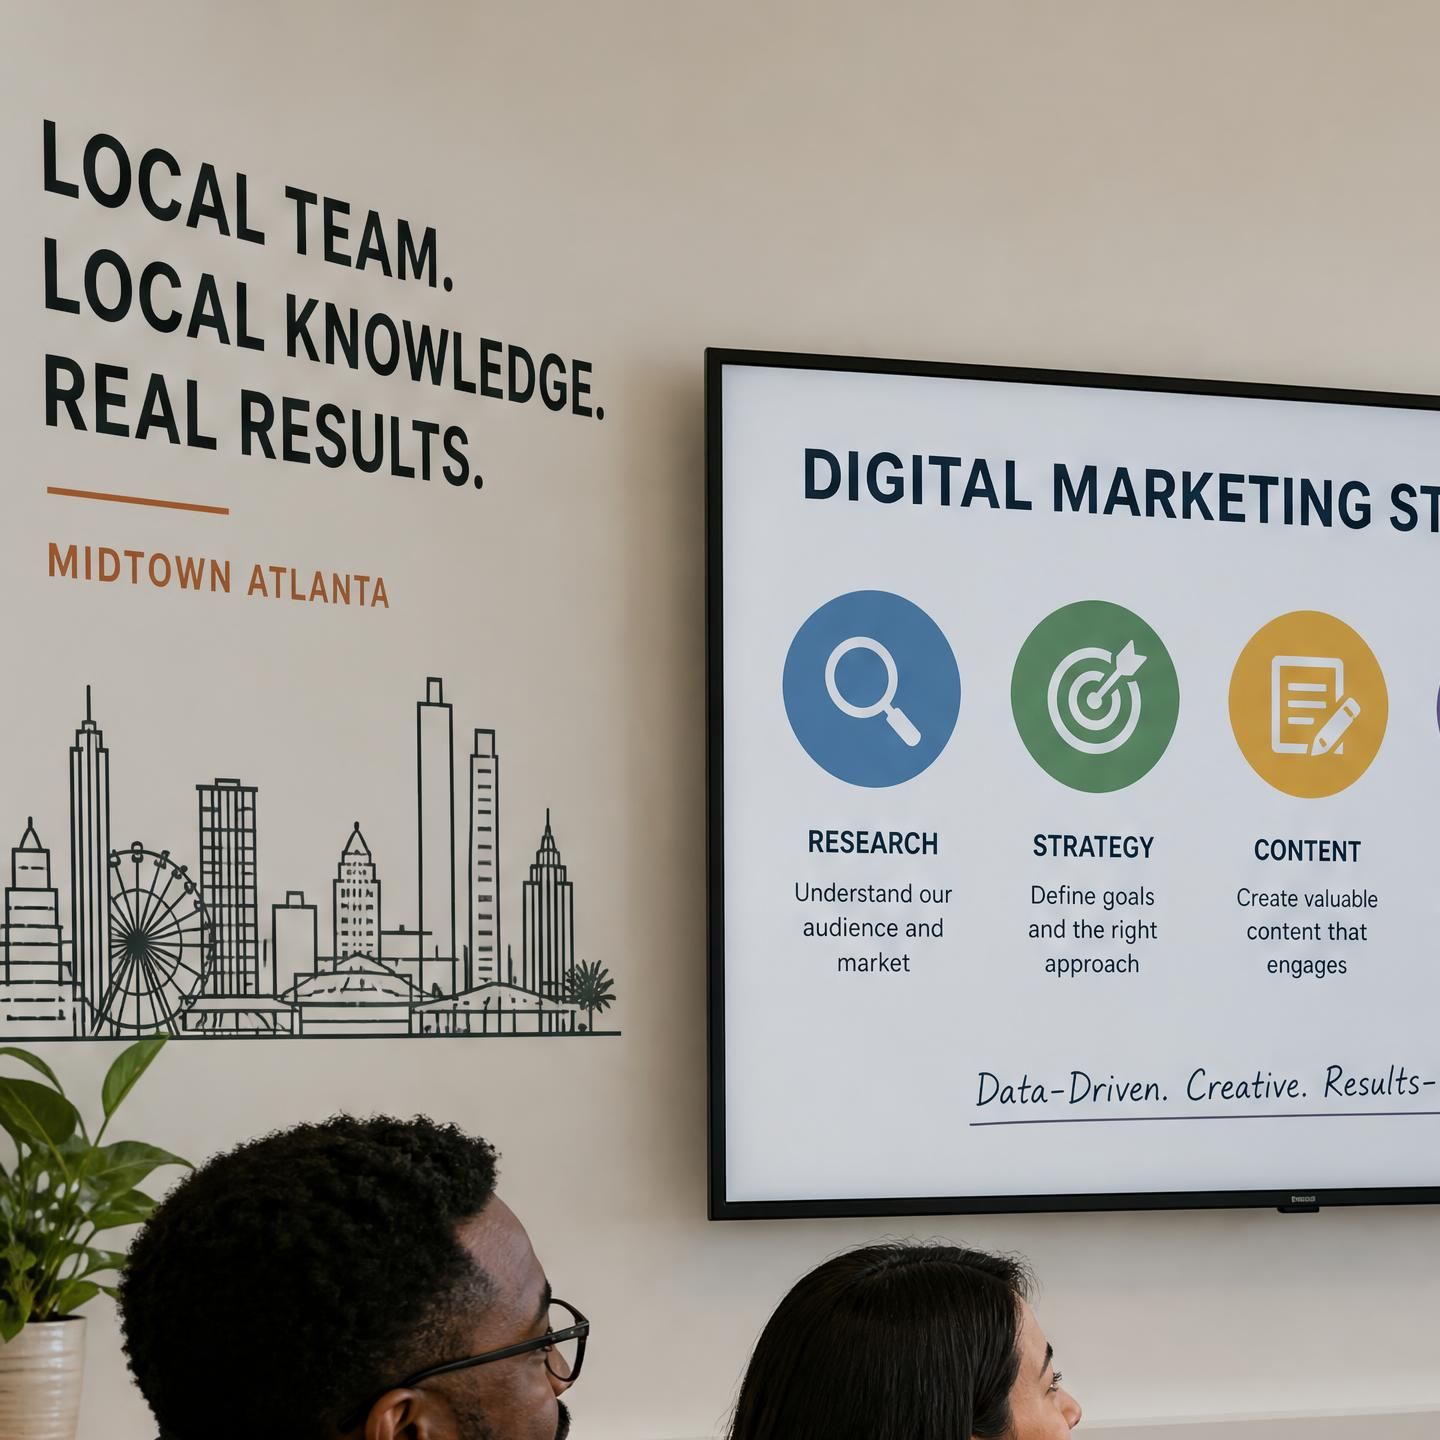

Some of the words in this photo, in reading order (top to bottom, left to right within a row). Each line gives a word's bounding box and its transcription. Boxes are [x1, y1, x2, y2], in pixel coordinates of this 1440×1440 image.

[43, 119, 265, 245] LOCAL
[285, 186, 452, 292] TEAM.
[44, 237, 265, 351] LOCAL
[286, 293, 604, 421] KNOWLEDGE.
[45, 354, 217, 450] REAL
[241, 389, 483, 489] RESULTS.
[805, 448, 1032, 510] DIGITAL
[1054, 464, 1371, 529] MARKETING
[49, 543, 230, 593] MIDTOWN
[248, 565, 389, 608] ATLANTA
[809, 830, 937, 854] RESEARCH
[1034, 834, 1154, 858] STRATEGY
[1255, 839, 1361, 862] CONTENT
[796, 883, 912, 903] Understand
[920, 889, 952, 903] our
[1032, 885, 1095, 905] Define
[1104, 886, 1154, 910] goals
[1237, 888, 1298, 907] Create
[1305, 889, 1377, 908] valuable
[804, 917, 898, 937] audience
[906, 918, 942, 937] and
[1029, 919, 1065, 938] and
[1073, 919, 1104, 938] the
[1112, 920, 1157, 944] right
[1247, 923, 1321, 940] content
[1328, 922, 1367, 940] that
[839, 952, 910, 972] market
[1045, 954, 1138, 977] approach
[1268, 959, 1346, 978] engages
[976, 1071, 1167, 1106] Data-Driven.
[1187, 1068, 1306, 1101] Creative.
